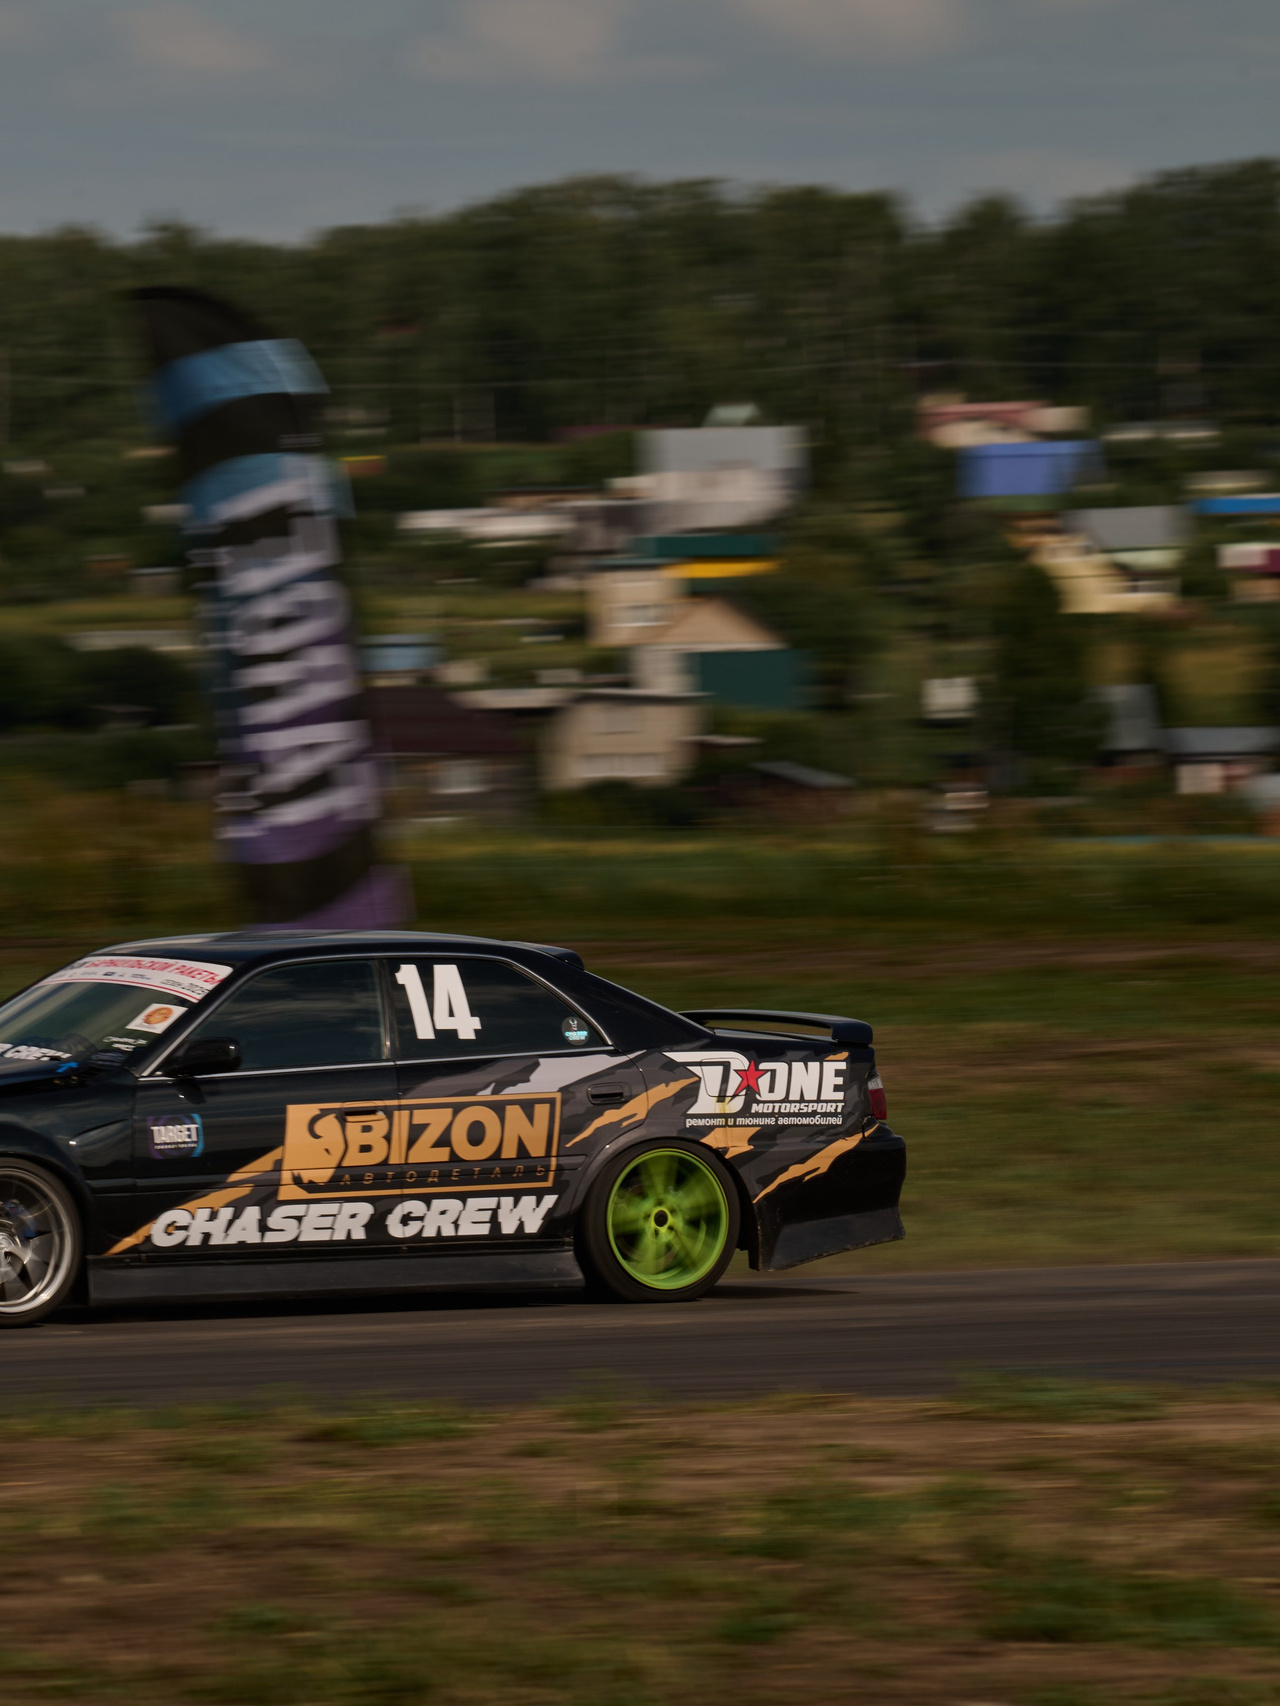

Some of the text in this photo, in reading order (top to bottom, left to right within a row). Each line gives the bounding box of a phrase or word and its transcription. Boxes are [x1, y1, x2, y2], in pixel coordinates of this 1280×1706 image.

[394, 963, 482, 1040] 14
[750, 1102, 846, 1114] MOTORSPORT
[685, 1114, 843, 1128] ремонт и тюнинг автомобилей
[150, 1123, 200, 1144] TARGET
[340, 1103, 551, 1167] BIZON
[340, 1165, 547, 1186] АВТОДЕТАЛЬ
[150, 1194, 560, 1248] CHASER CREW
